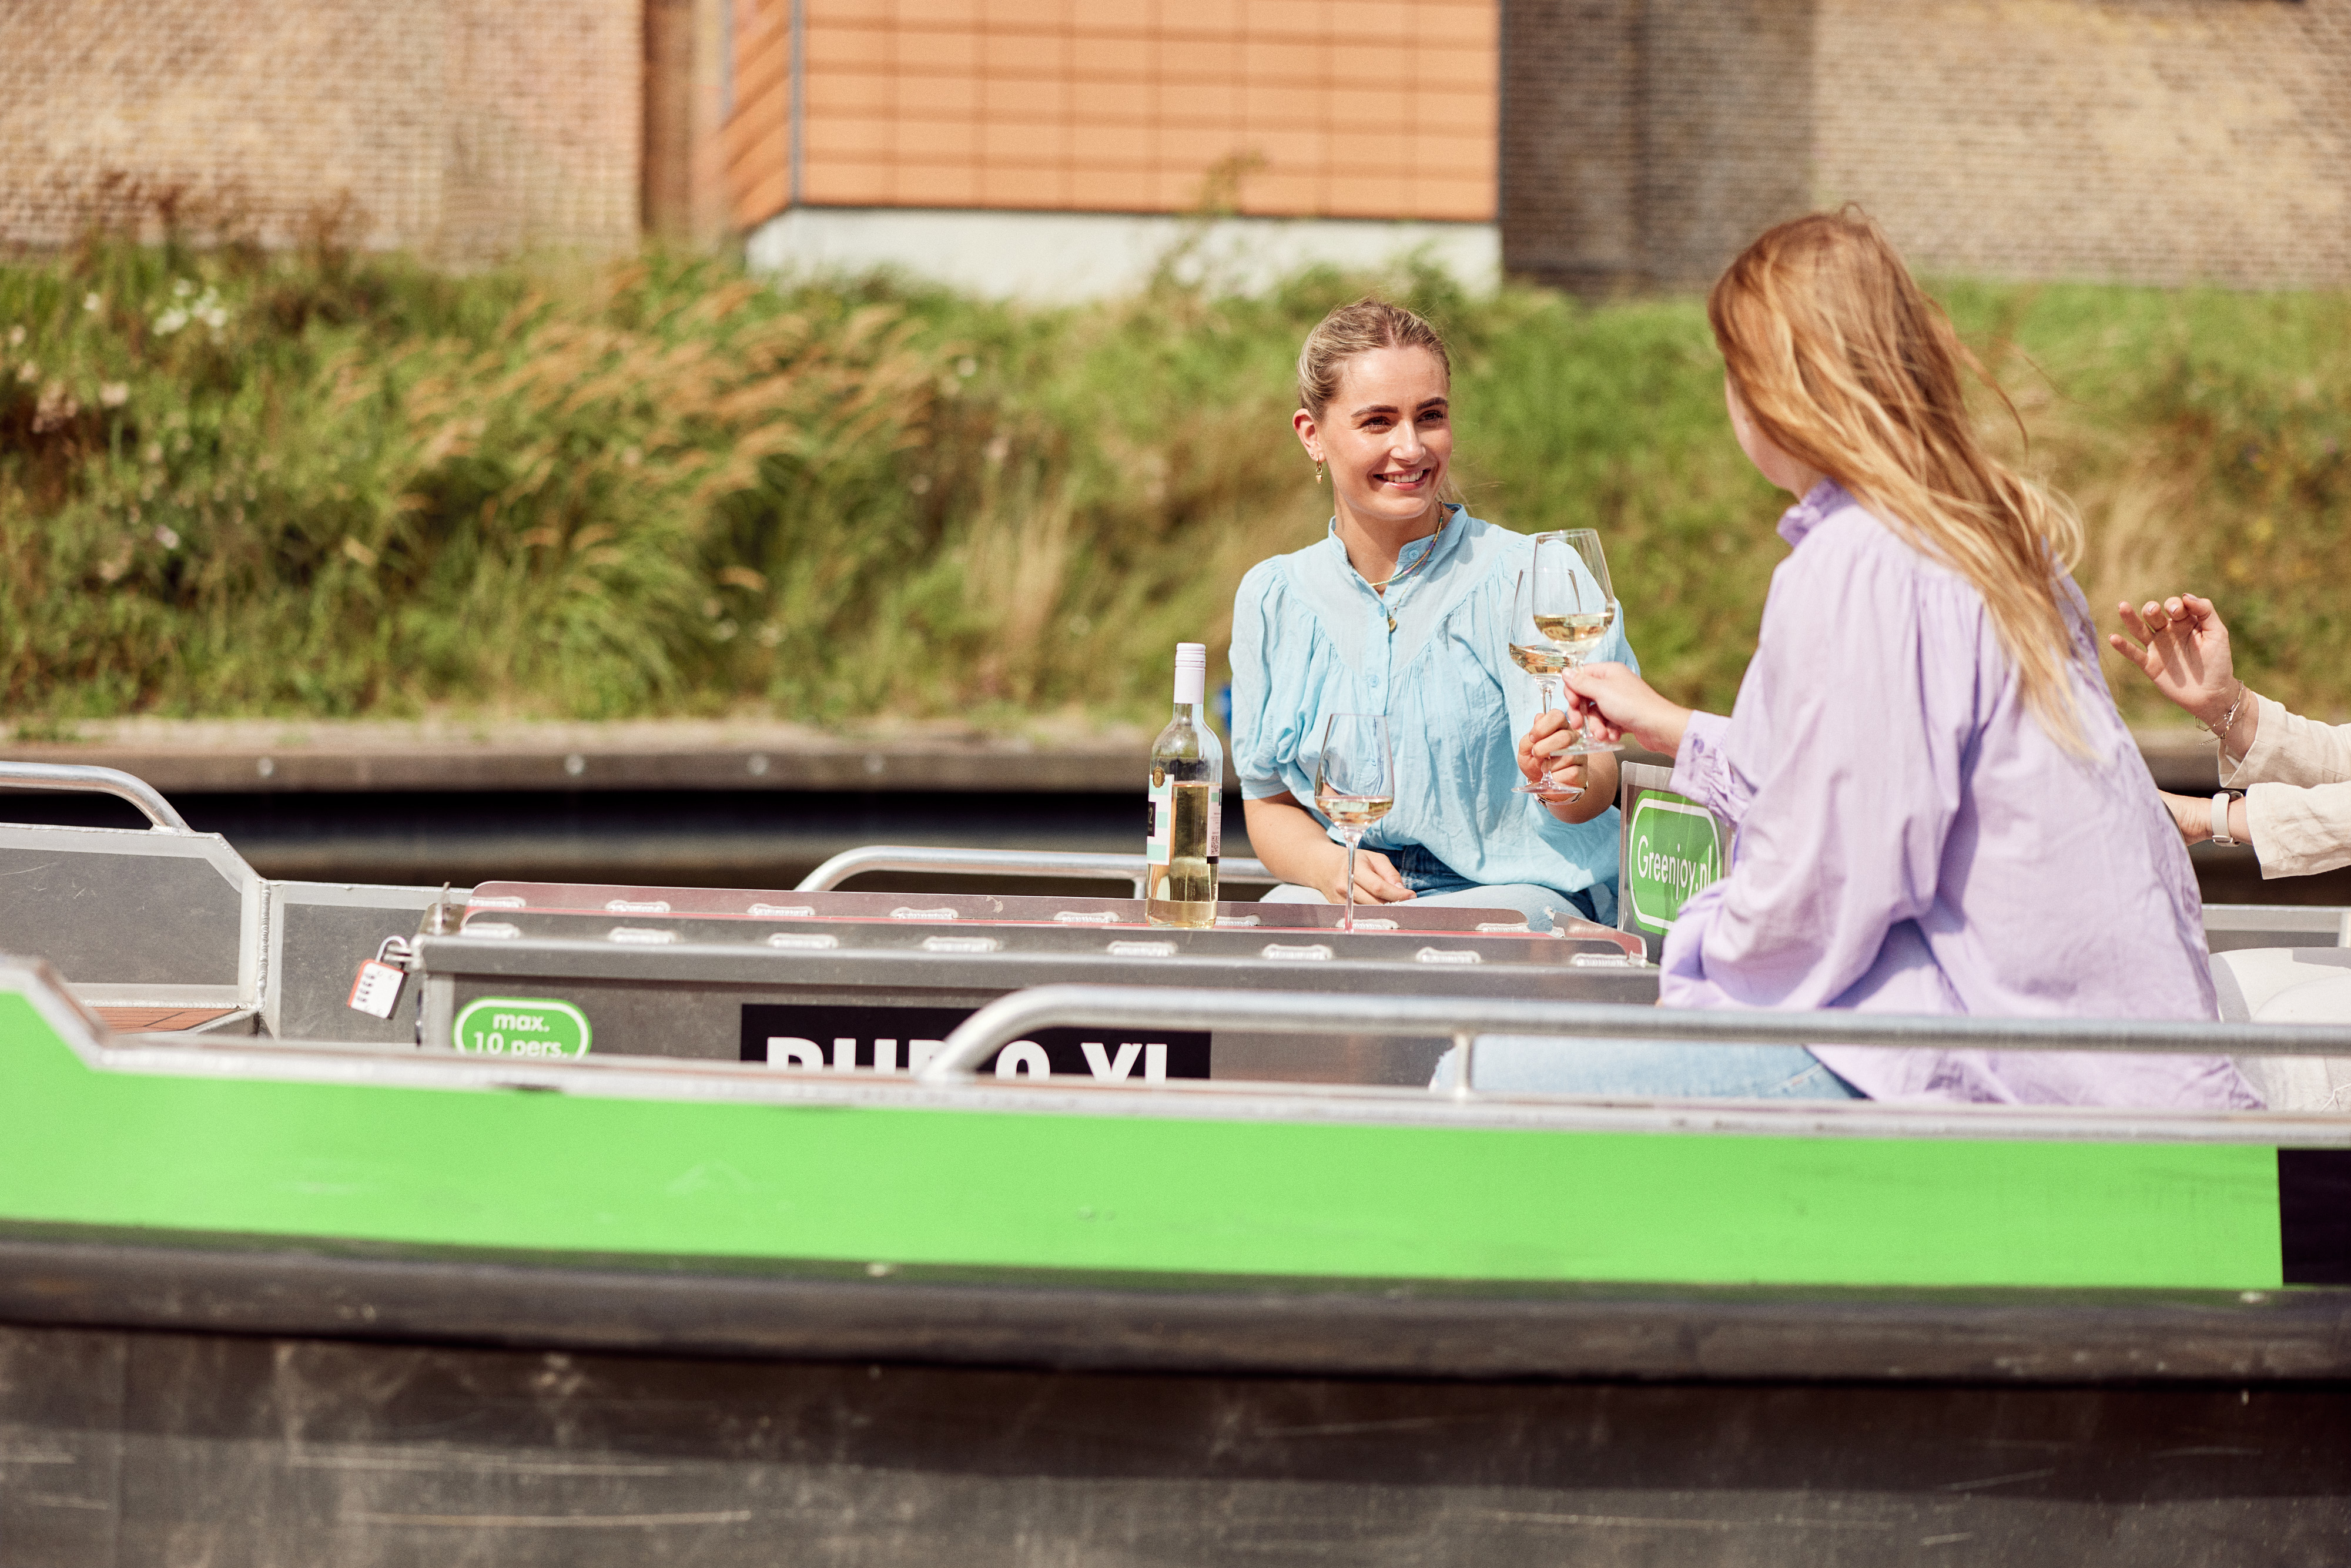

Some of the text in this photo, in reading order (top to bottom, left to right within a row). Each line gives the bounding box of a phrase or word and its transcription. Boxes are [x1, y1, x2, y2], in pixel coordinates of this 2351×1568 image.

[1638, 835, 1712, 901] Greenjoy.nl
[493, 1014, 550, 1032] max.
[474, 1031, 568, 1058] 10 pers.
